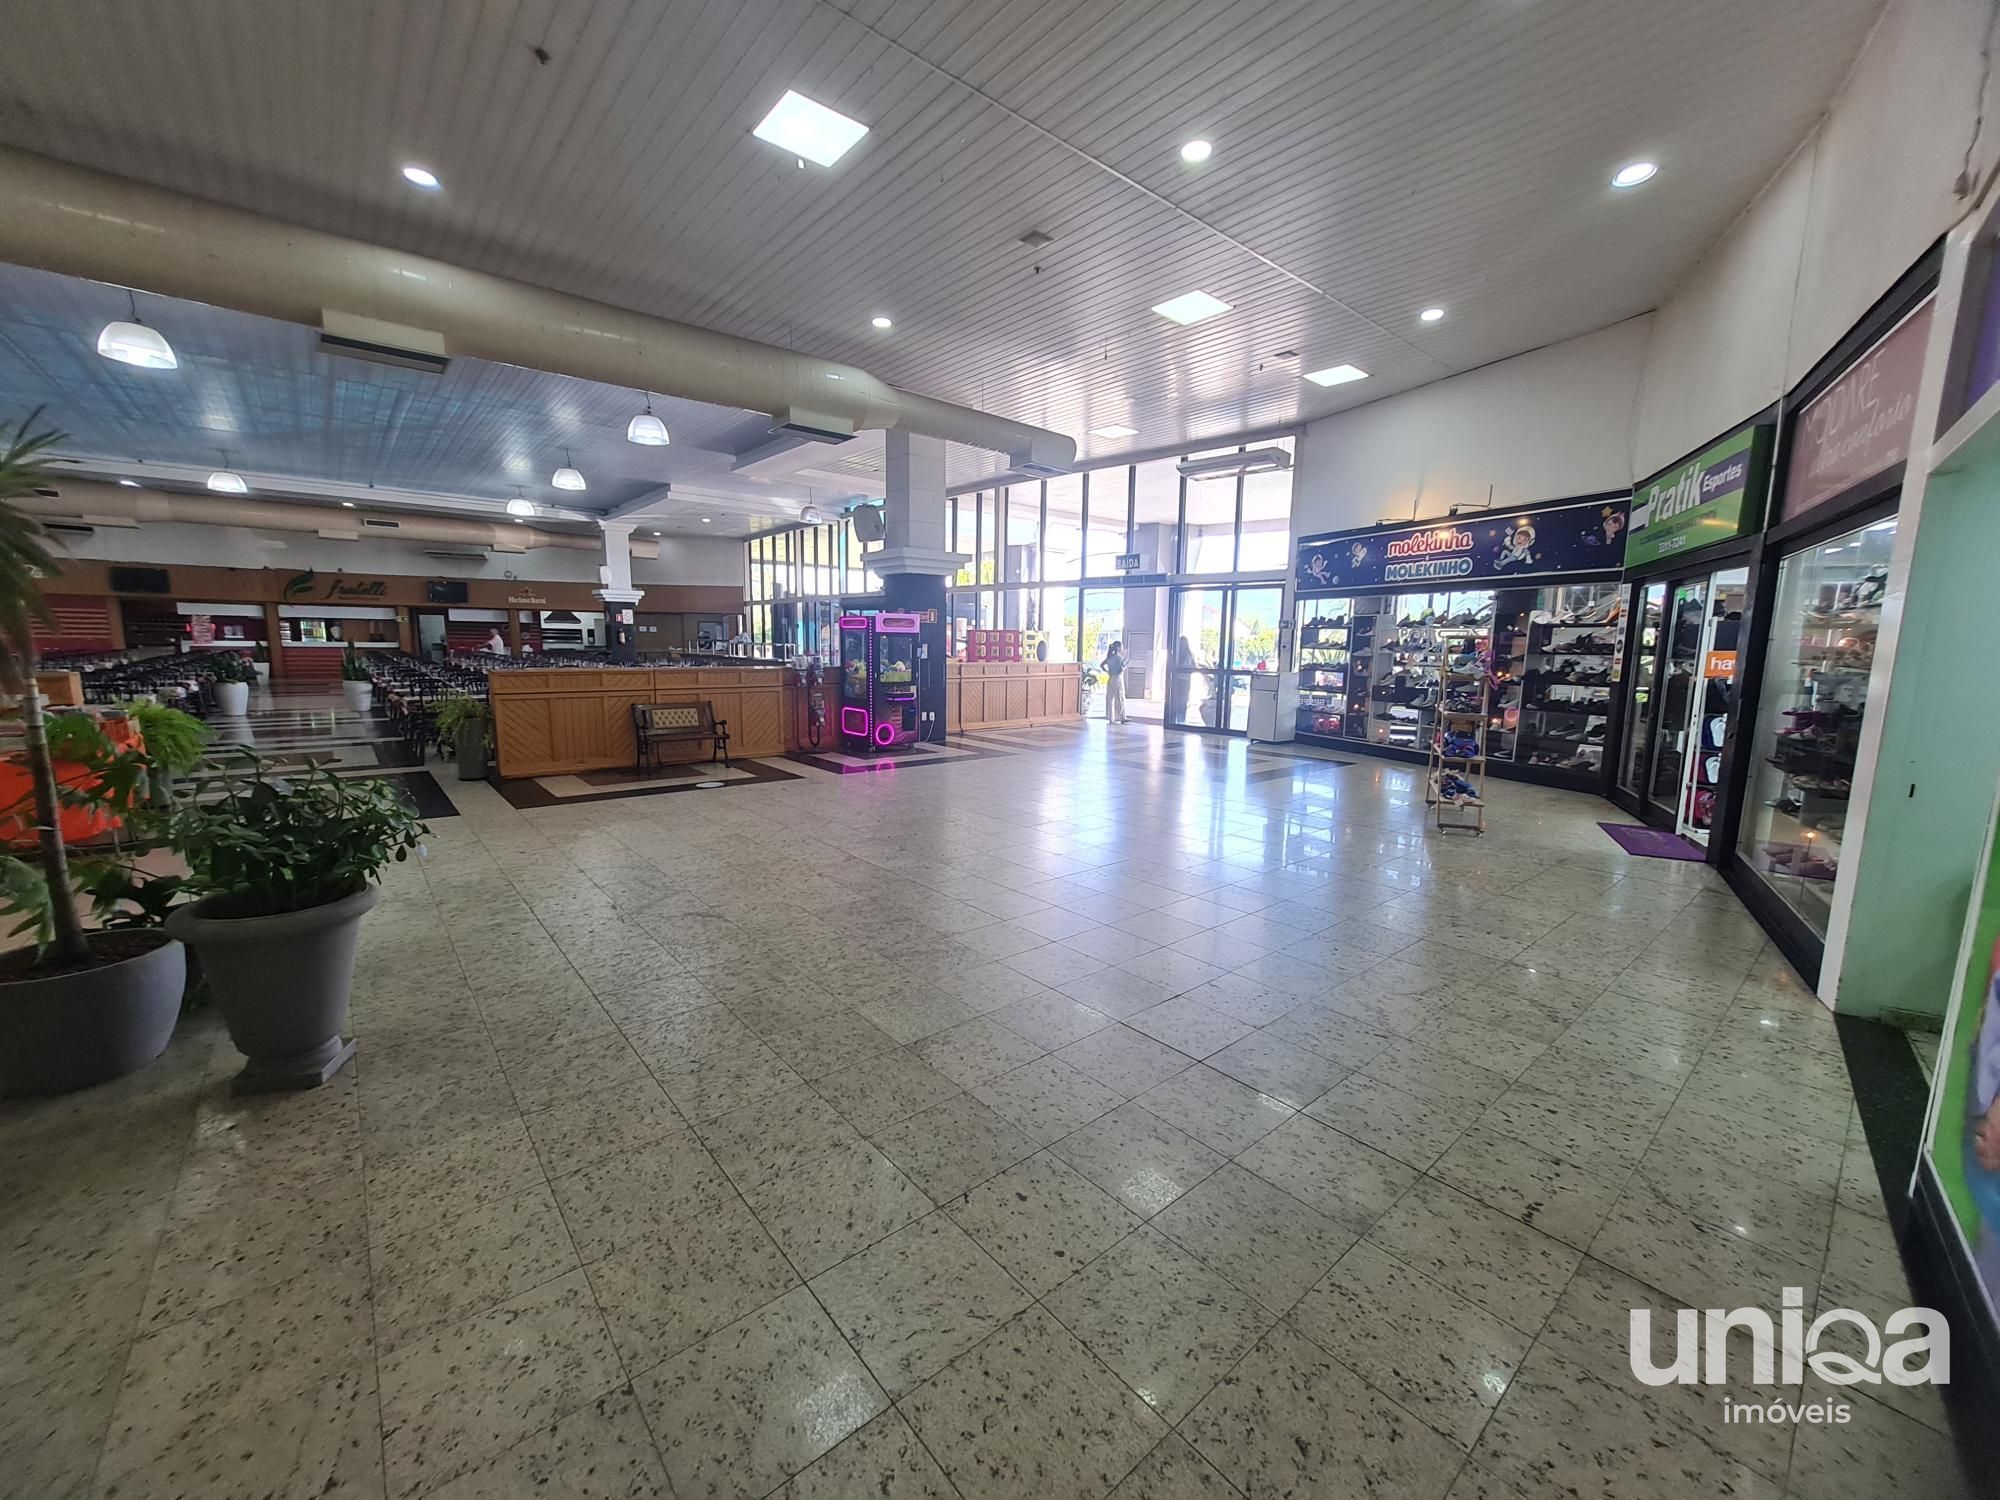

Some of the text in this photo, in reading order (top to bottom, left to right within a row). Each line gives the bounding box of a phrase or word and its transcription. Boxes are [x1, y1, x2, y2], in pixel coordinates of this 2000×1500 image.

[1645, 461, 1706, 527] Pratik
[1702, 463, 1744, 492] Esportes
[1388, 528, 1474, 557] molekinha
[1385, 557, 1473, 581] MOLEKINHO
